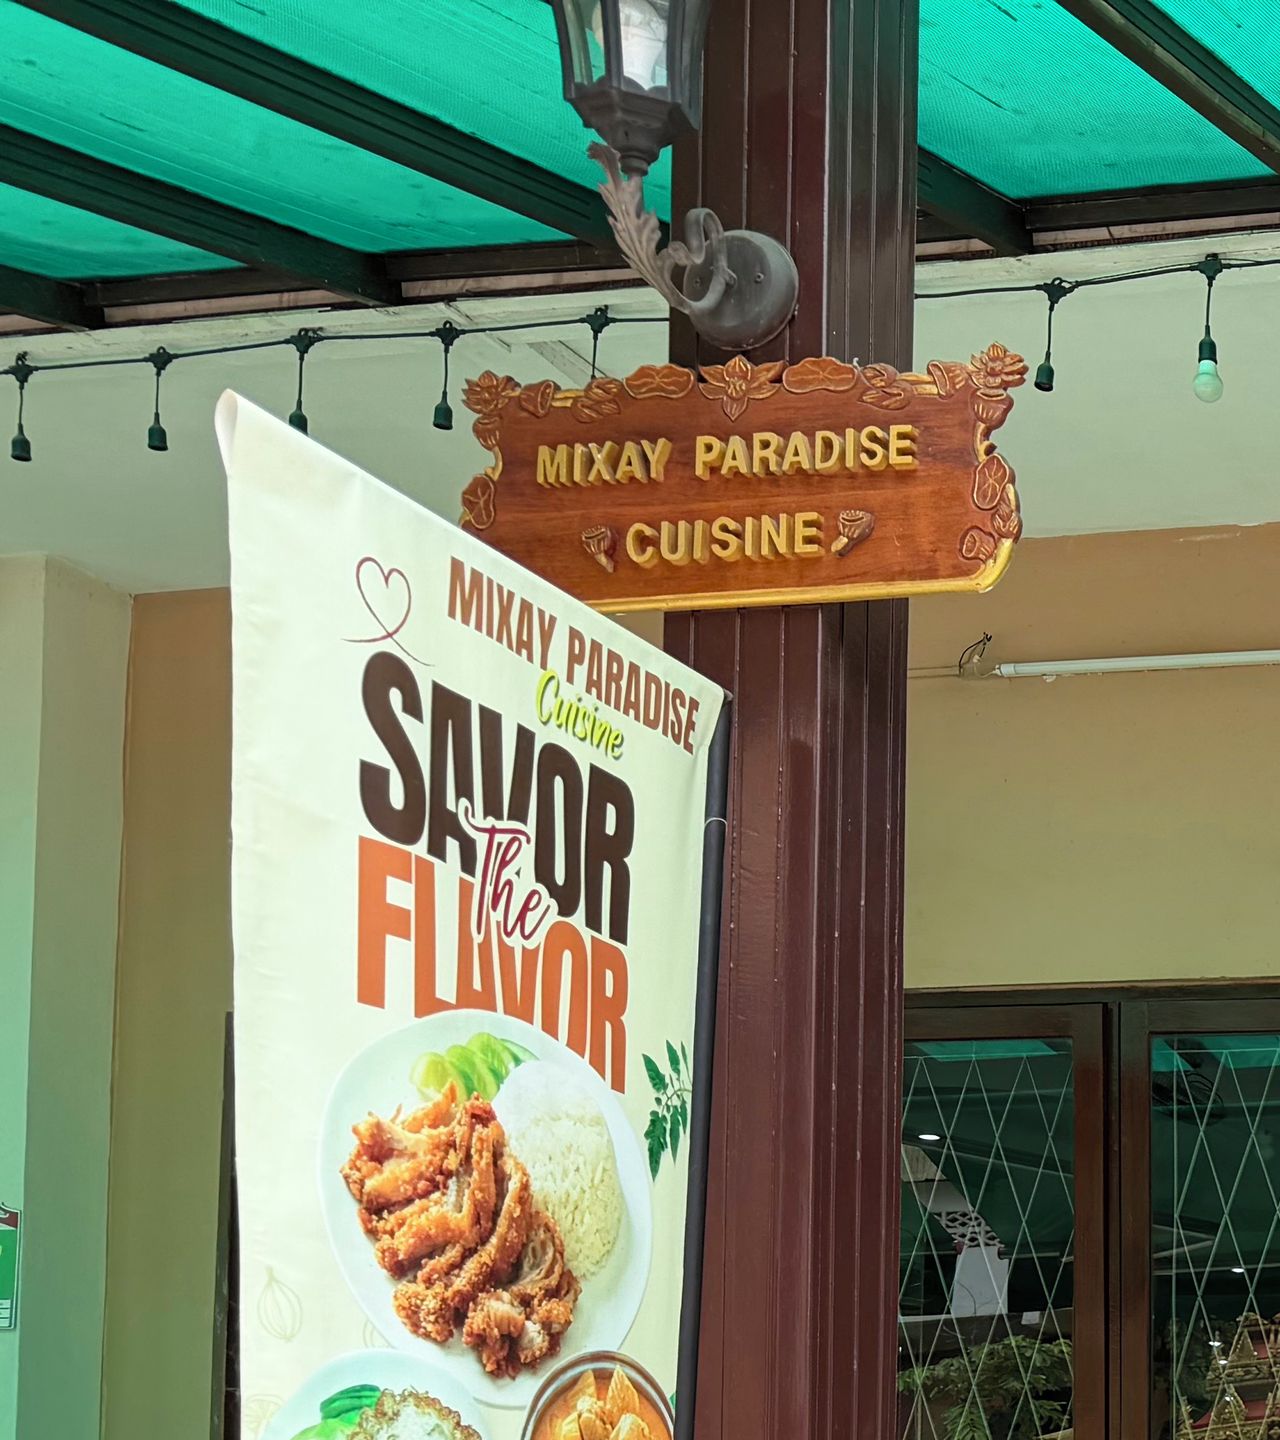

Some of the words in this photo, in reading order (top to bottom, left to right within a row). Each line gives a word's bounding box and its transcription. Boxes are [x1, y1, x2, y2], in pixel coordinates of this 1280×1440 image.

[536, 438, 669, 487] MIXAY
[695, 425, 919, 479] PARADISE
[625, 511, 827, 566] CUISINE
[447, 557, 557, 672] MIXAY
[566, 628, 702, 757] PARADISE
[536, 668, 625, 760] Cuisine
[359, 651, 637, 945] SAVOR
[458, 797, 557, 941] The
[357, 836, 628, 1095] FLAVOR
